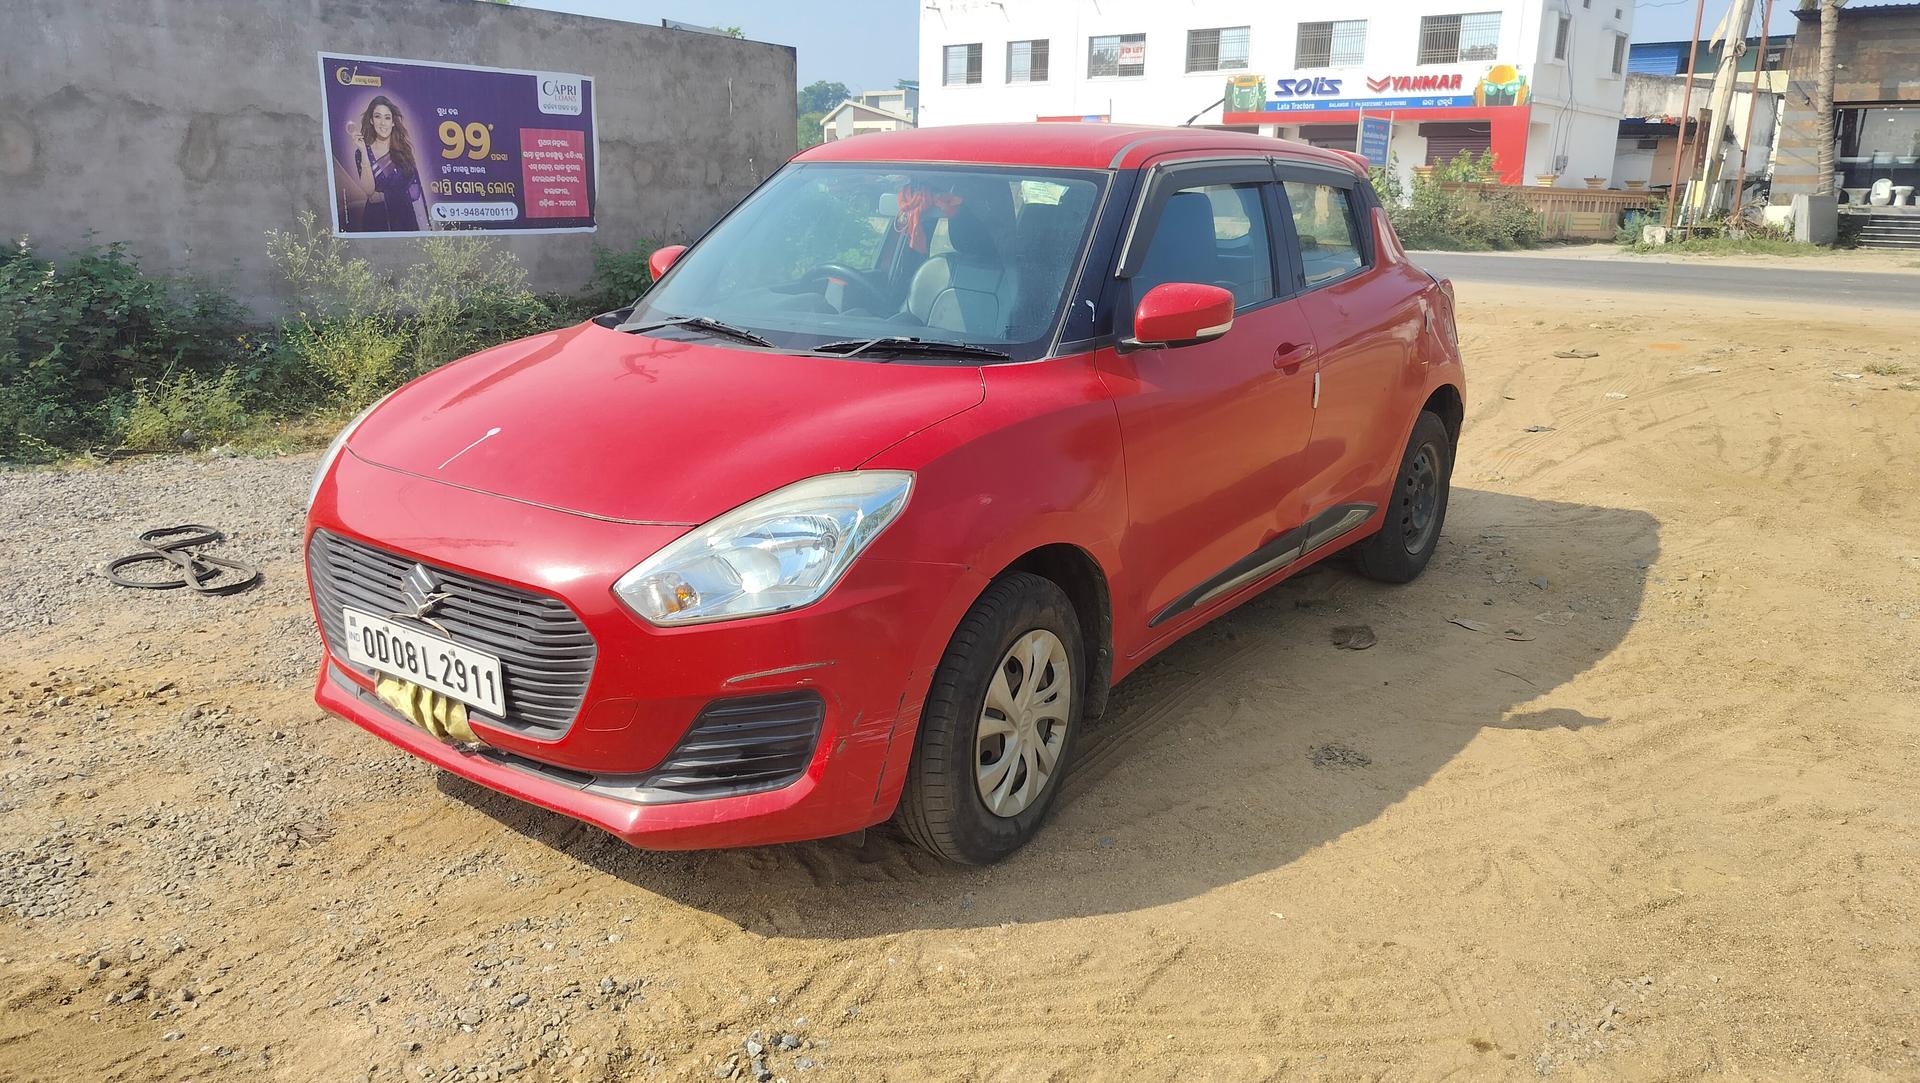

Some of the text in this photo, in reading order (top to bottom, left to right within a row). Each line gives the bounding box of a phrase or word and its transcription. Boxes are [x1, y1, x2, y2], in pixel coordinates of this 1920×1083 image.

[542, 80, 577, 96] CAPRI
[1391, 74, 1463, 92] YANMAR
[1292, 102, 1315, 110] Tractors
[449, 207, 514, 217] 91-9484700111
